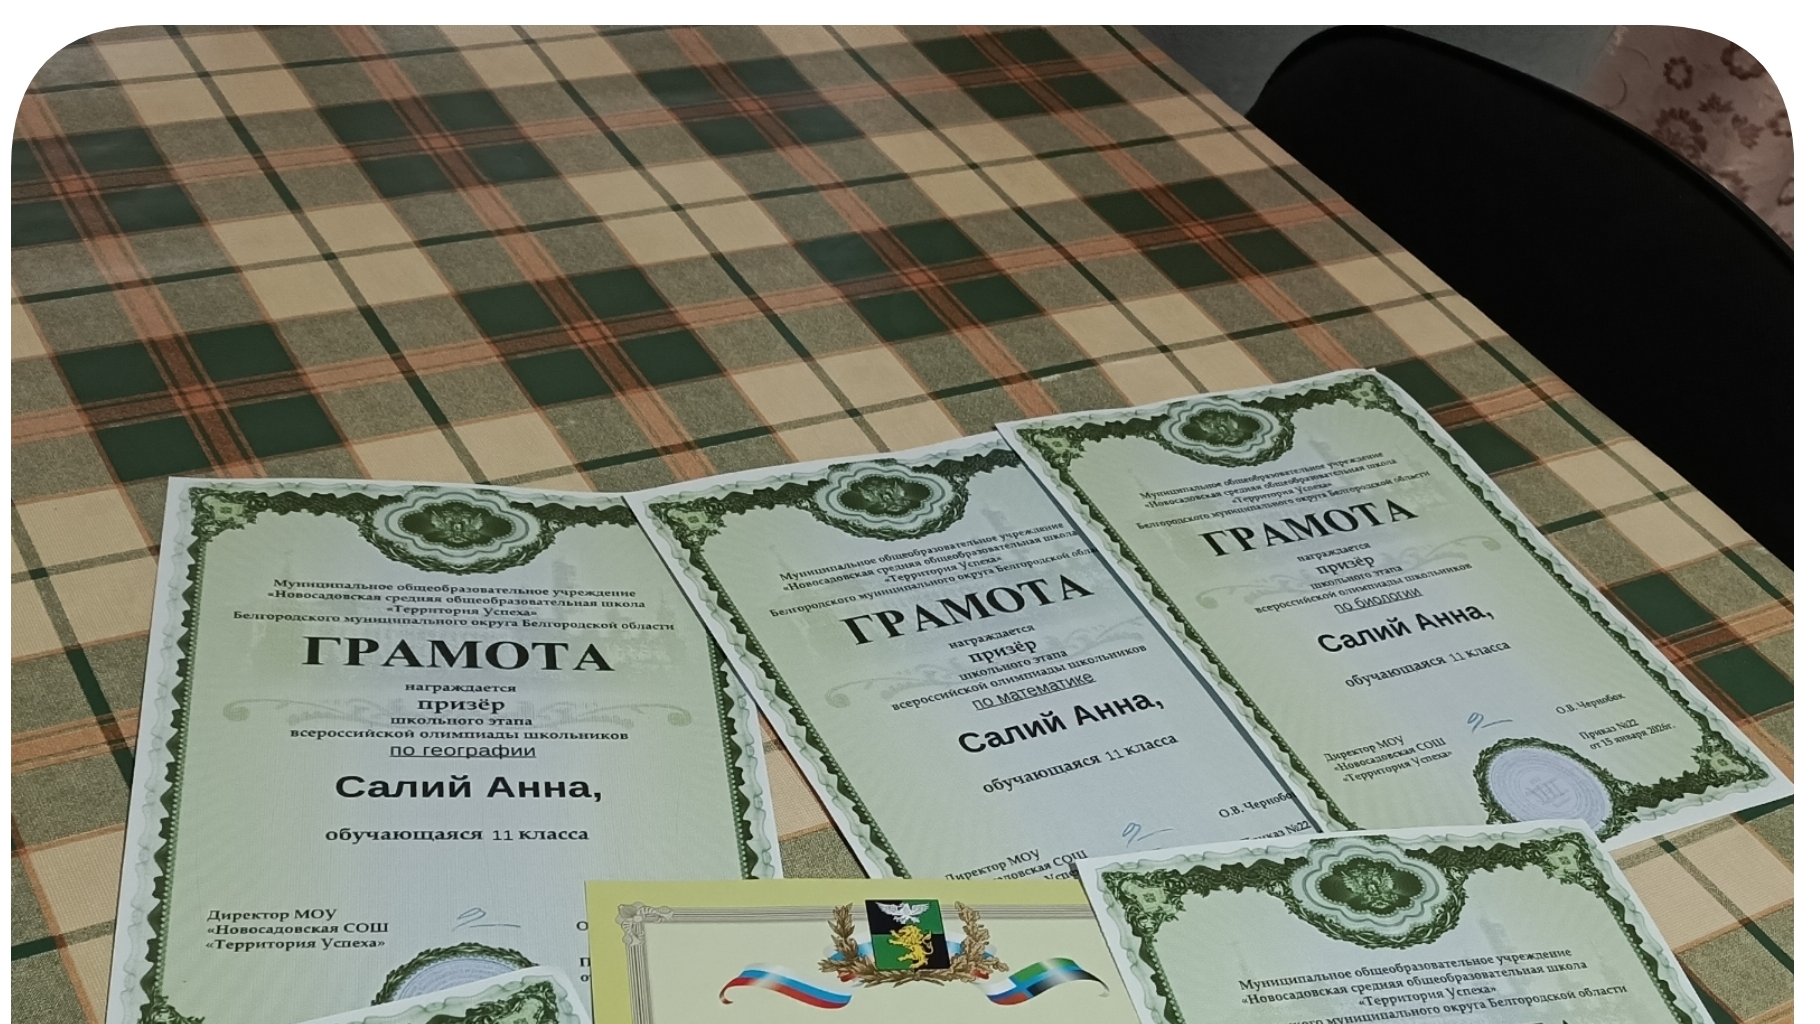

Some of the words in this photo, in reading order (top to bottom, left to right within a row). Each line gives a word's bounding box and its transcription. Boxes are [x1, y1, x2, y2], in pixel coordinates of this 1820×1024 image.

[1198, 499, 1418, 557] ГРАМОТА
[1315, 556, 1374, 576] призёр
[839, 574, 1095, 645] ГРАМОТА
[1333, 602, 1354, 614] по
[1354, 587, 1424, 610] биологии
[1318, 617, 1412, 652] Салий
[1415, 606, 1494, 631] Анна,
[302, 636, 615, 671] ГРАМОТА
[968, 641, 1037, 664] призёр
[1345, 657, 1447, 687] обучающаяся
[1449, 652, 1466, 662] 11
[1465, 642, 1511, 658] класса
[405, 684, 516, 694] награждается
[972, 698, 995, 711] по
[996, 672, 1097, 706] математике
[418, 698, 505, 714] призёр
[291, 729, 414, 740] всероссийской
[420, 731, 519, 739] олимпиады
[524, 732, 629, 740] школьников
[489, 718, 532, 726] этапа
[958, 710, 1067, 753] Салий
[1074, 694, 1164, 726] Анна,
[389, 745, 416, 758] по
[423, 744, 537, 760] географии
[983, 755, 1101, 793] обучающаяся
[1105, 749, 1124, 761] 11
[1123, 735, 1178, 755] класса
[336, 775, 471, 798] Салий
[487, 777, 601, 802] Анна,
[325, 828, 482, 845] обучающаяся
[493, 830, 513, 841] 11
[519, 831, 589, 840] класса
